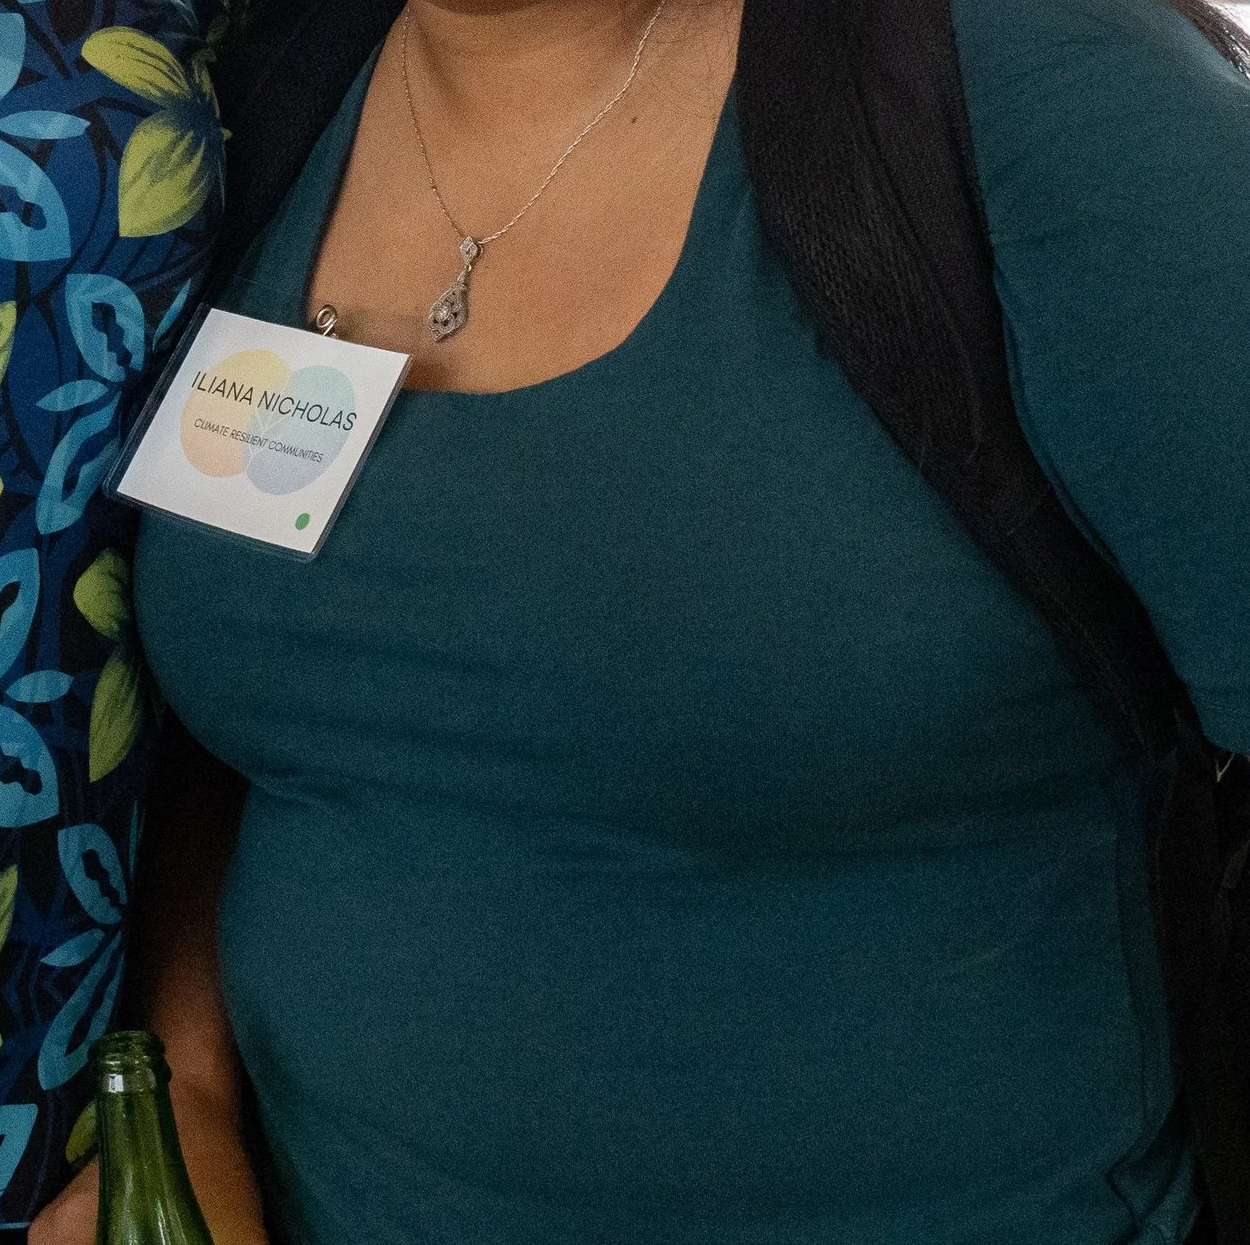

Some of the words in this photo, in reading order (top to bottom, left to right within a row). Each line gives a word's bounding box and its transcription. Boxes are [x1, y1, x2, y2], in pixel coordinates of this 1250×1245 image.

[191, 372, 254, 405] ILIANA
[257, 390, 357, 431] NICHOLAS
[194, 418, 230, 437] CLIMATE
[230, 428, 269, 447] RESILIENT
[268, 440, 323, 462] COMMUNITIES
